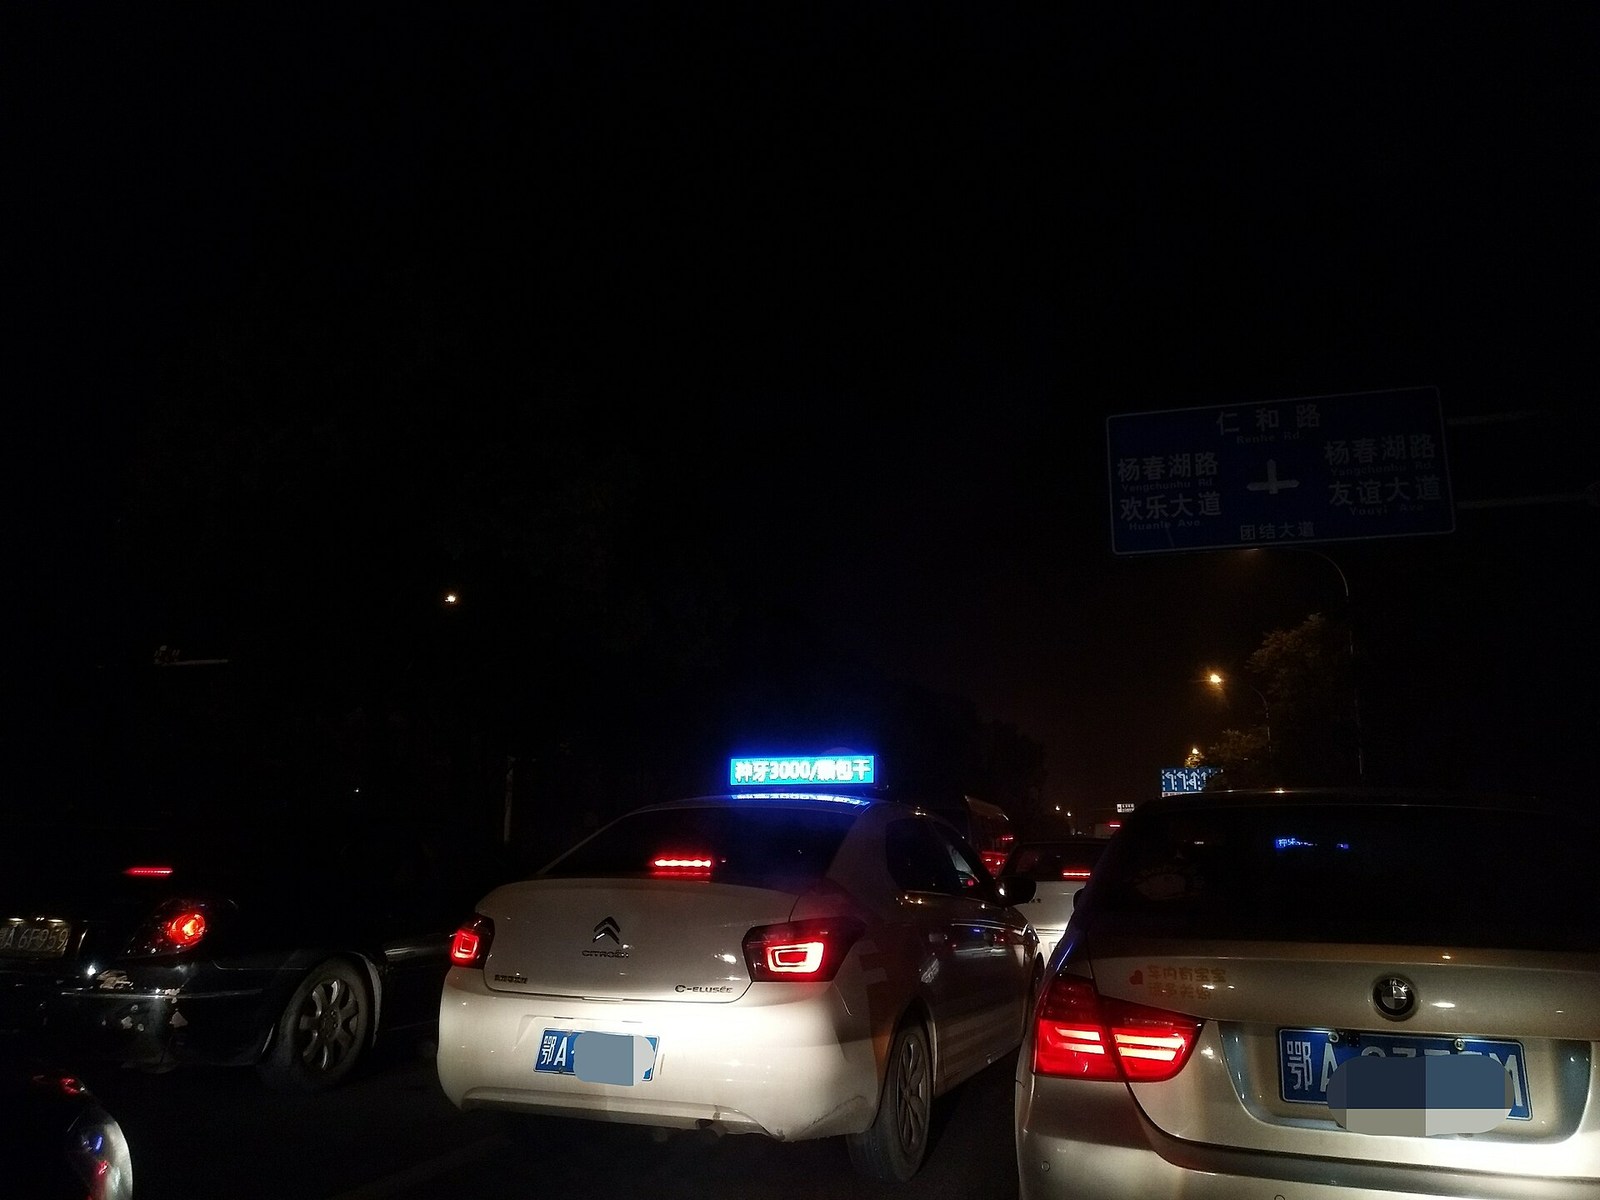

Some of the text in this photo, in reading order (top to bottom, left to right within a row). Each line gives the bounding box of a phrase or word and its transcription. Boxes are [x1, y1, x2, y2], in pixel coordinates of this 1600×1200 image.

[1216, 403, 1320, 436] 仁和路
[1324, 433, 1436, 465] 杨春湖路
[1117, 451, 1218, 482] 杨春湖路
[1120, 491, 1222, 520] 欢乐大道
[1328, 474, 1441, 506] 友谊大道
[1240, 521, 1315, 540] 团结大道
